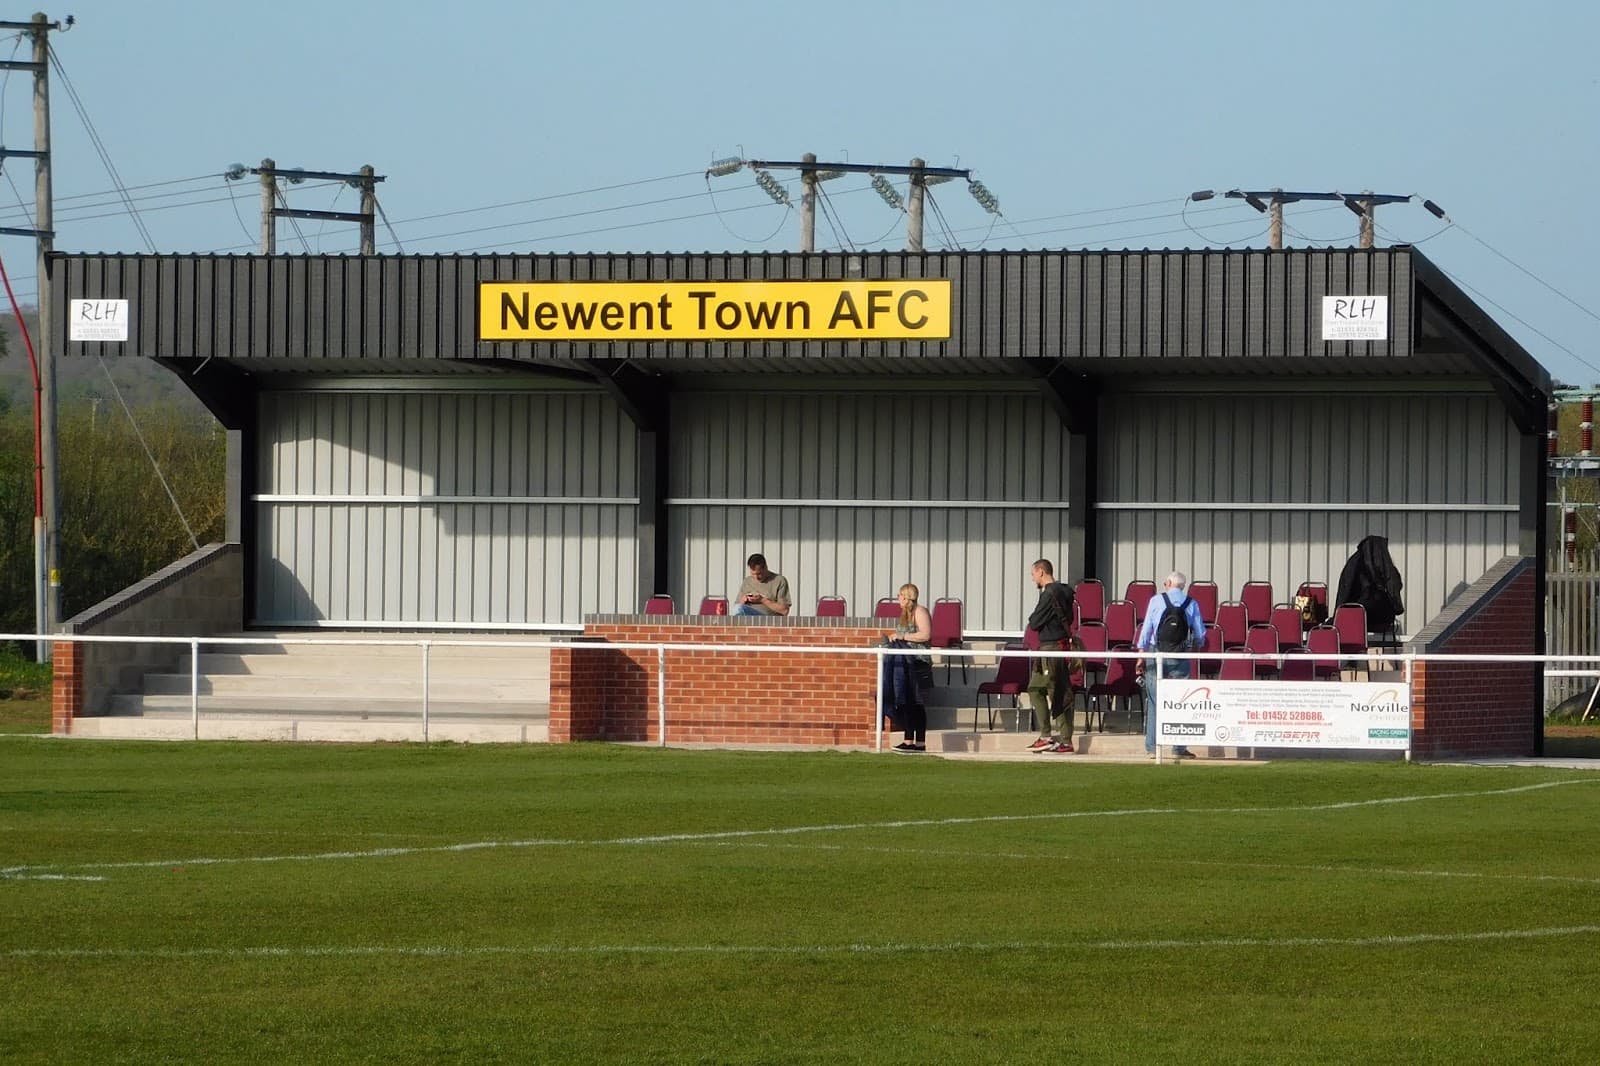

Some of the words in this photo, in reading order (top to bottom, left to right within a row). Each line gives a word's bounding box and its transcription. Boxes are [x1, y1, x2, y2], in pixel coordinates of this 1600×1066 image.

[81, 302, 118, 321] RLH
[499, 291, 673, 331] Newent
[687, 290, 811, 330] Town
[827, 289, 930, 330] AFC
[1334, 298, 1376, 320] RLH
[1163, 700, 1222, 711] Norville
[1350, 702, 1409, 713] Norville
[1262, 710, 1288, 720] 01452
[1163, 724, 1205, 735] Barbour
